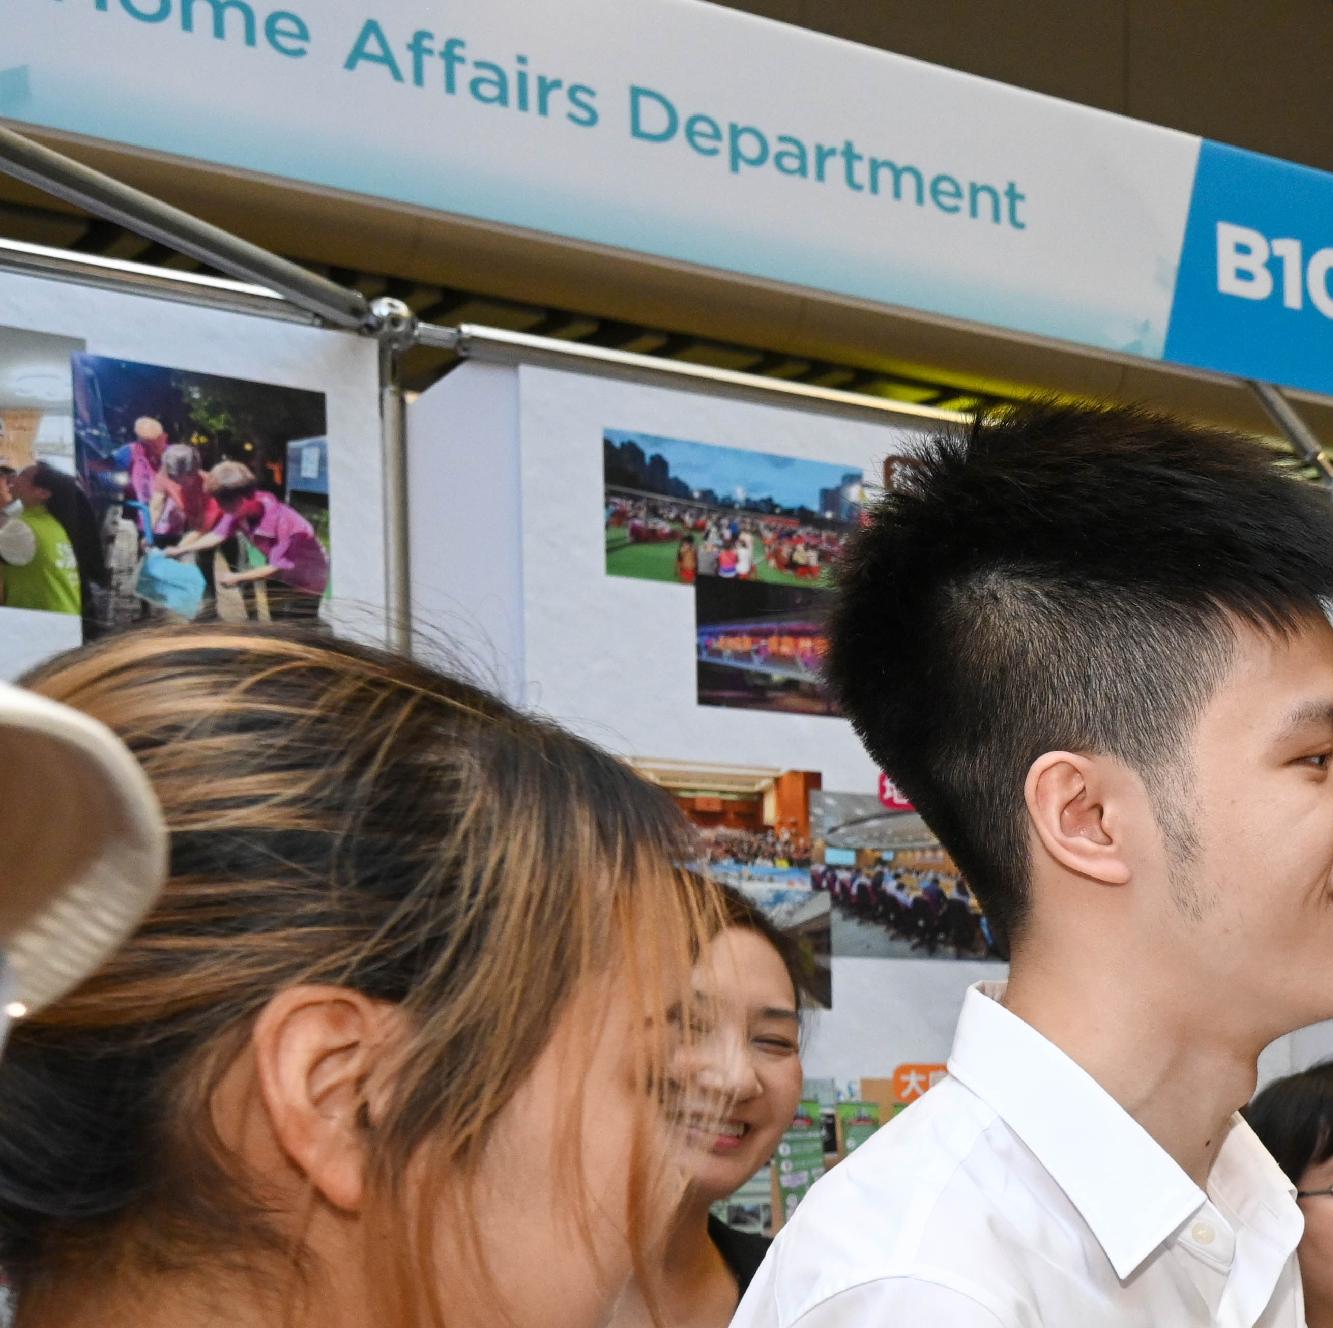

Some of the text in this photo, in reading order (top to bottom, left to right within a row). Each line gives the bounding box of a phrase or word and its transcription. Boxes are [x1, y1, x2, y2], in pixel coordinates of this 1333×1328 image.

[96, 0, 1027, 231] ome Affairs Department
